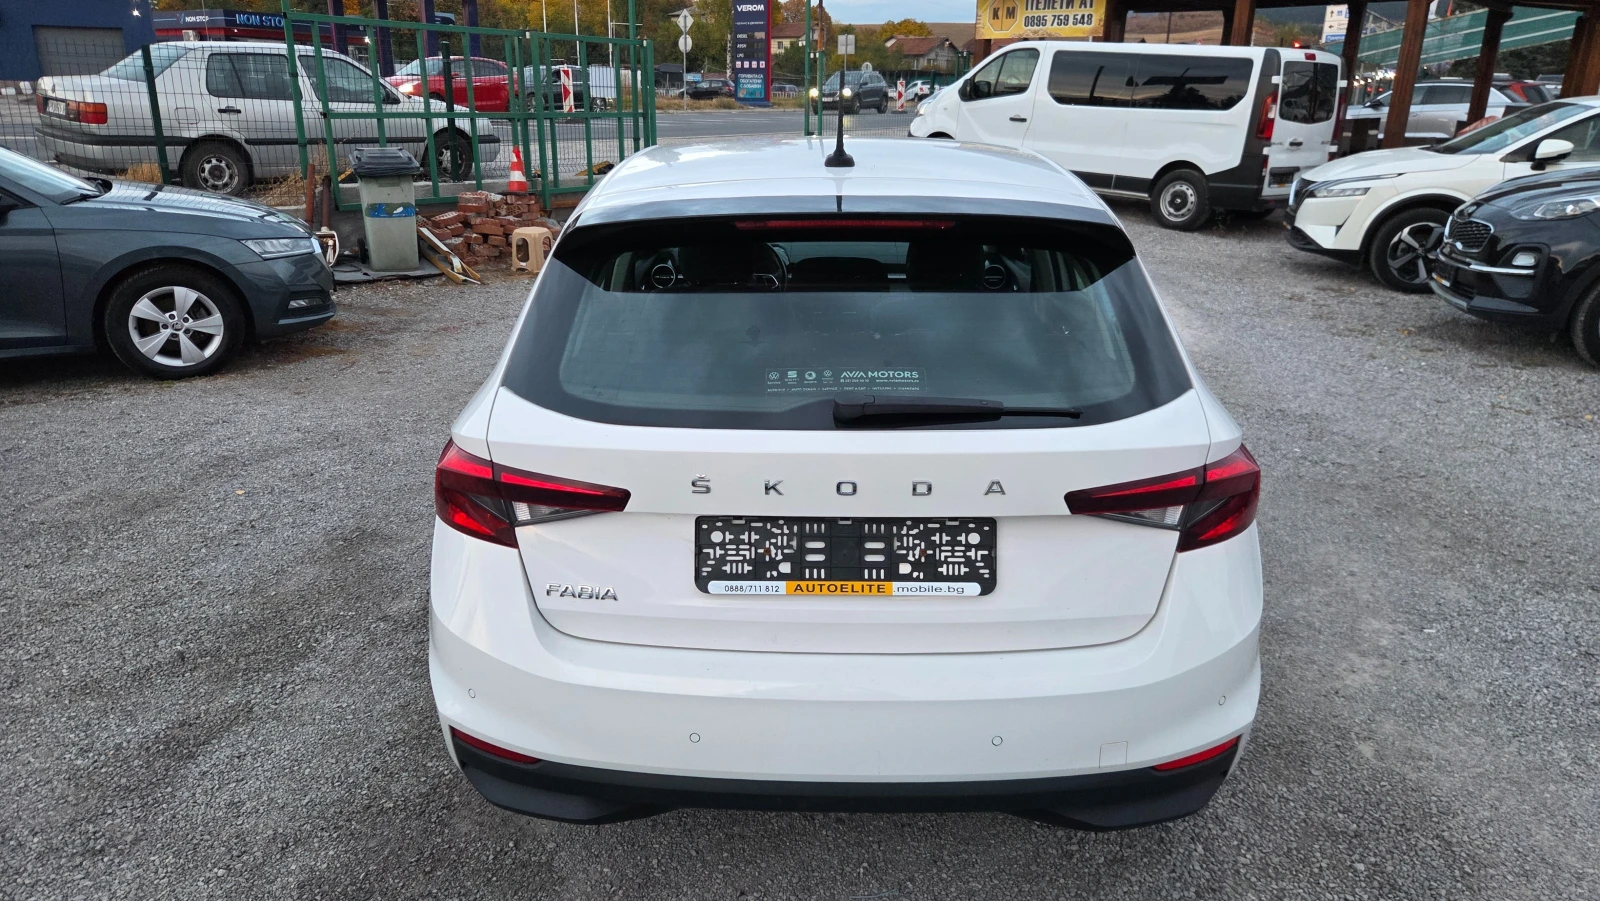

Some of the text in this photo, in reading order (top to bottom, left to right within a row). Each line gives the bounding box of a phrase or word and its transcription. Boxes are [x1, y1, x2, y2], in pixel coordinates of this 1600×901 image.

[236, 14, 283, 27] NON STO
[1024, 14, 1093, 27] 0895 759 548
[691, 474, 1006, 496] ŠKODA
[546, 583, 618, 601] FABIA
[724, 584, 762, 593] 0888/711
[794, 584, 886, 593] AUTOELITE
